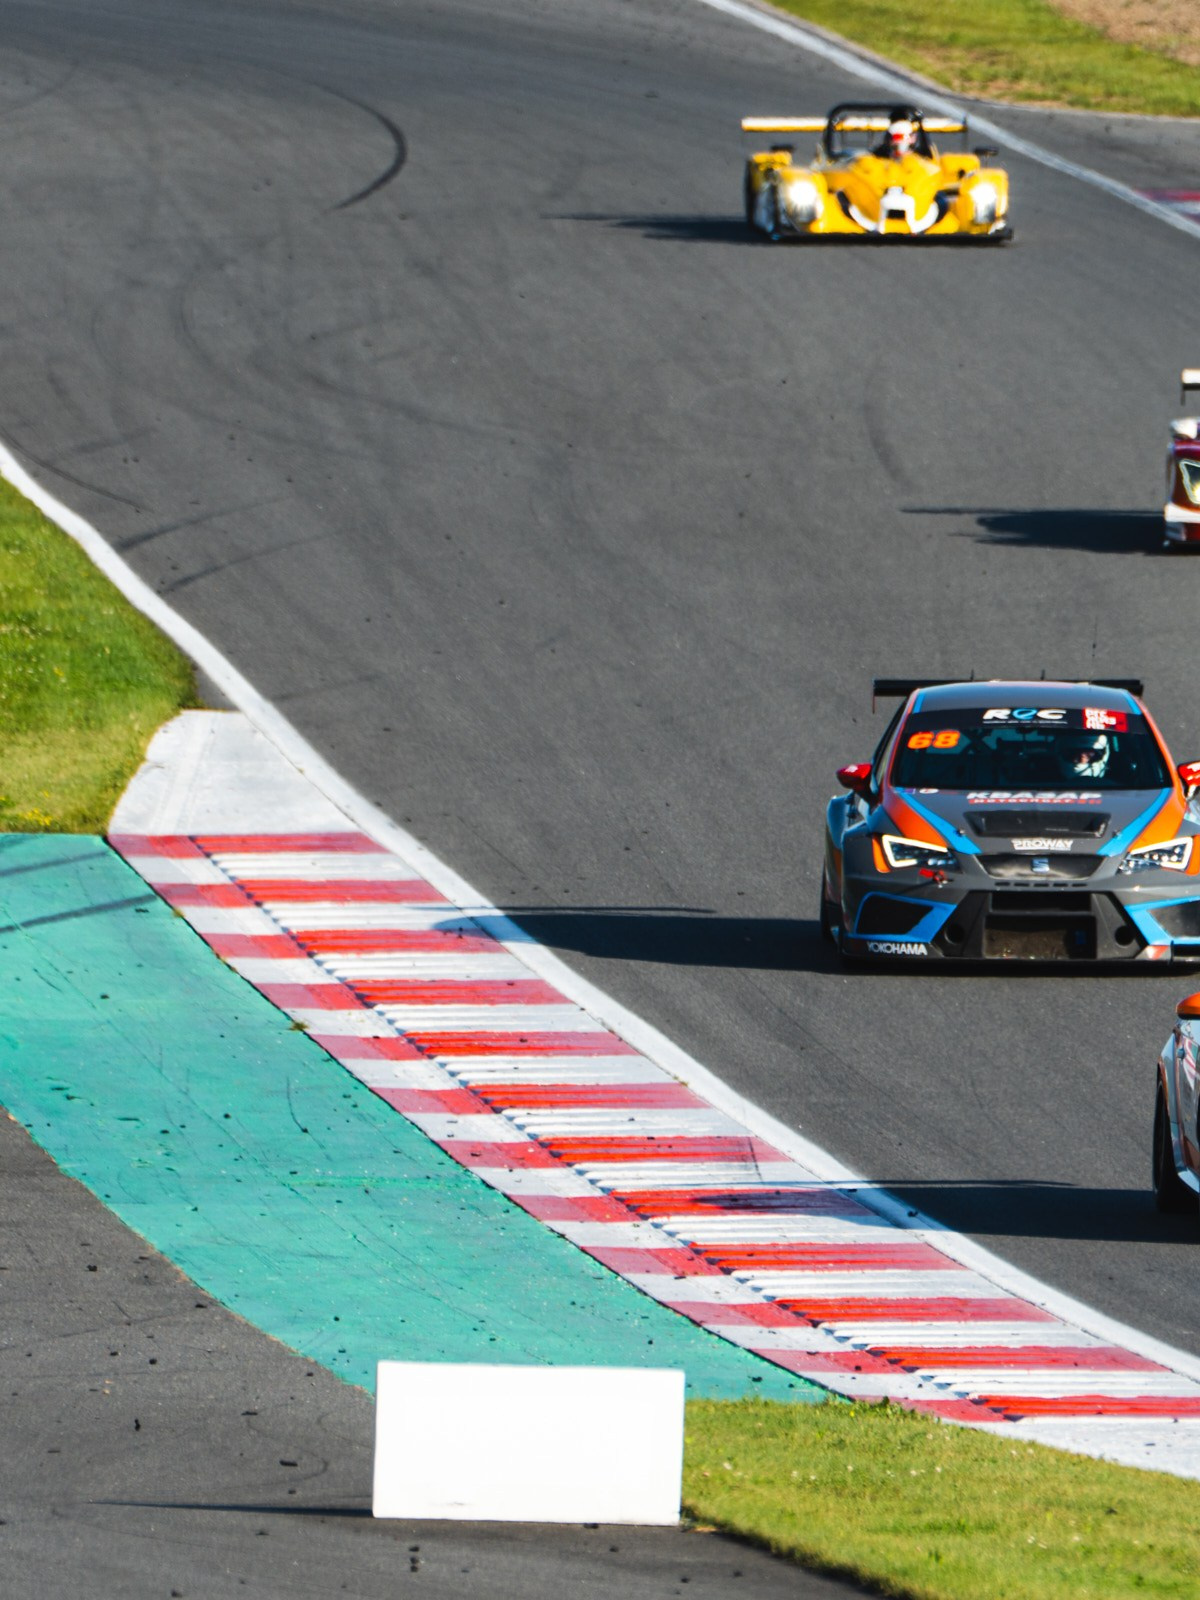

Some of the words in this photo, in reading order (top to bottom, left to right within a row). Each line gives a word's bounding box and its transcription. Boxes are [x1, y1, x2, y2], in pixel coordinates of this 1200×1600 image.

[907, 730, 961, 750] 68
[1011, 839, 1073, 851] PROWAY
[866, 941, 928, 956] YOKOHAMA
